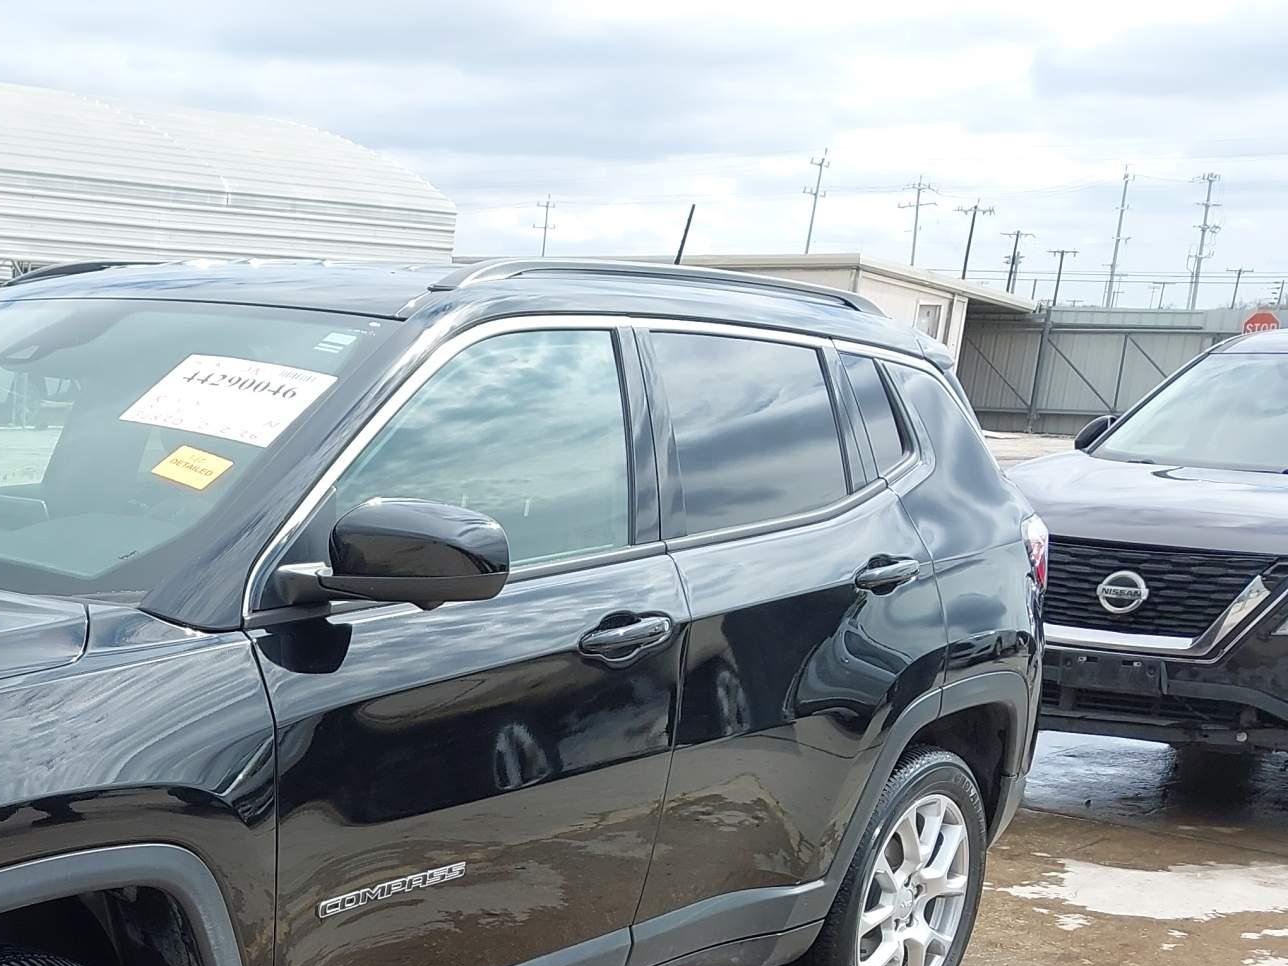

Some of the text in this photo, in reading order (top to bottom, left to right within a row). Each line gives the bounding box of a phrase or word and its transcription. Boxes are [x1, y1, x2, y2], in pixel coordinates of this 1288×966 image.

[1246, 323, 1278, 334] STOP
[183, 370, 297, 399] 44290046
[169, 458, 214, 476] DETAILED
[1102, 587, 1142, 597] NISSAN
[317, 861, 467, 919] COMPASS
